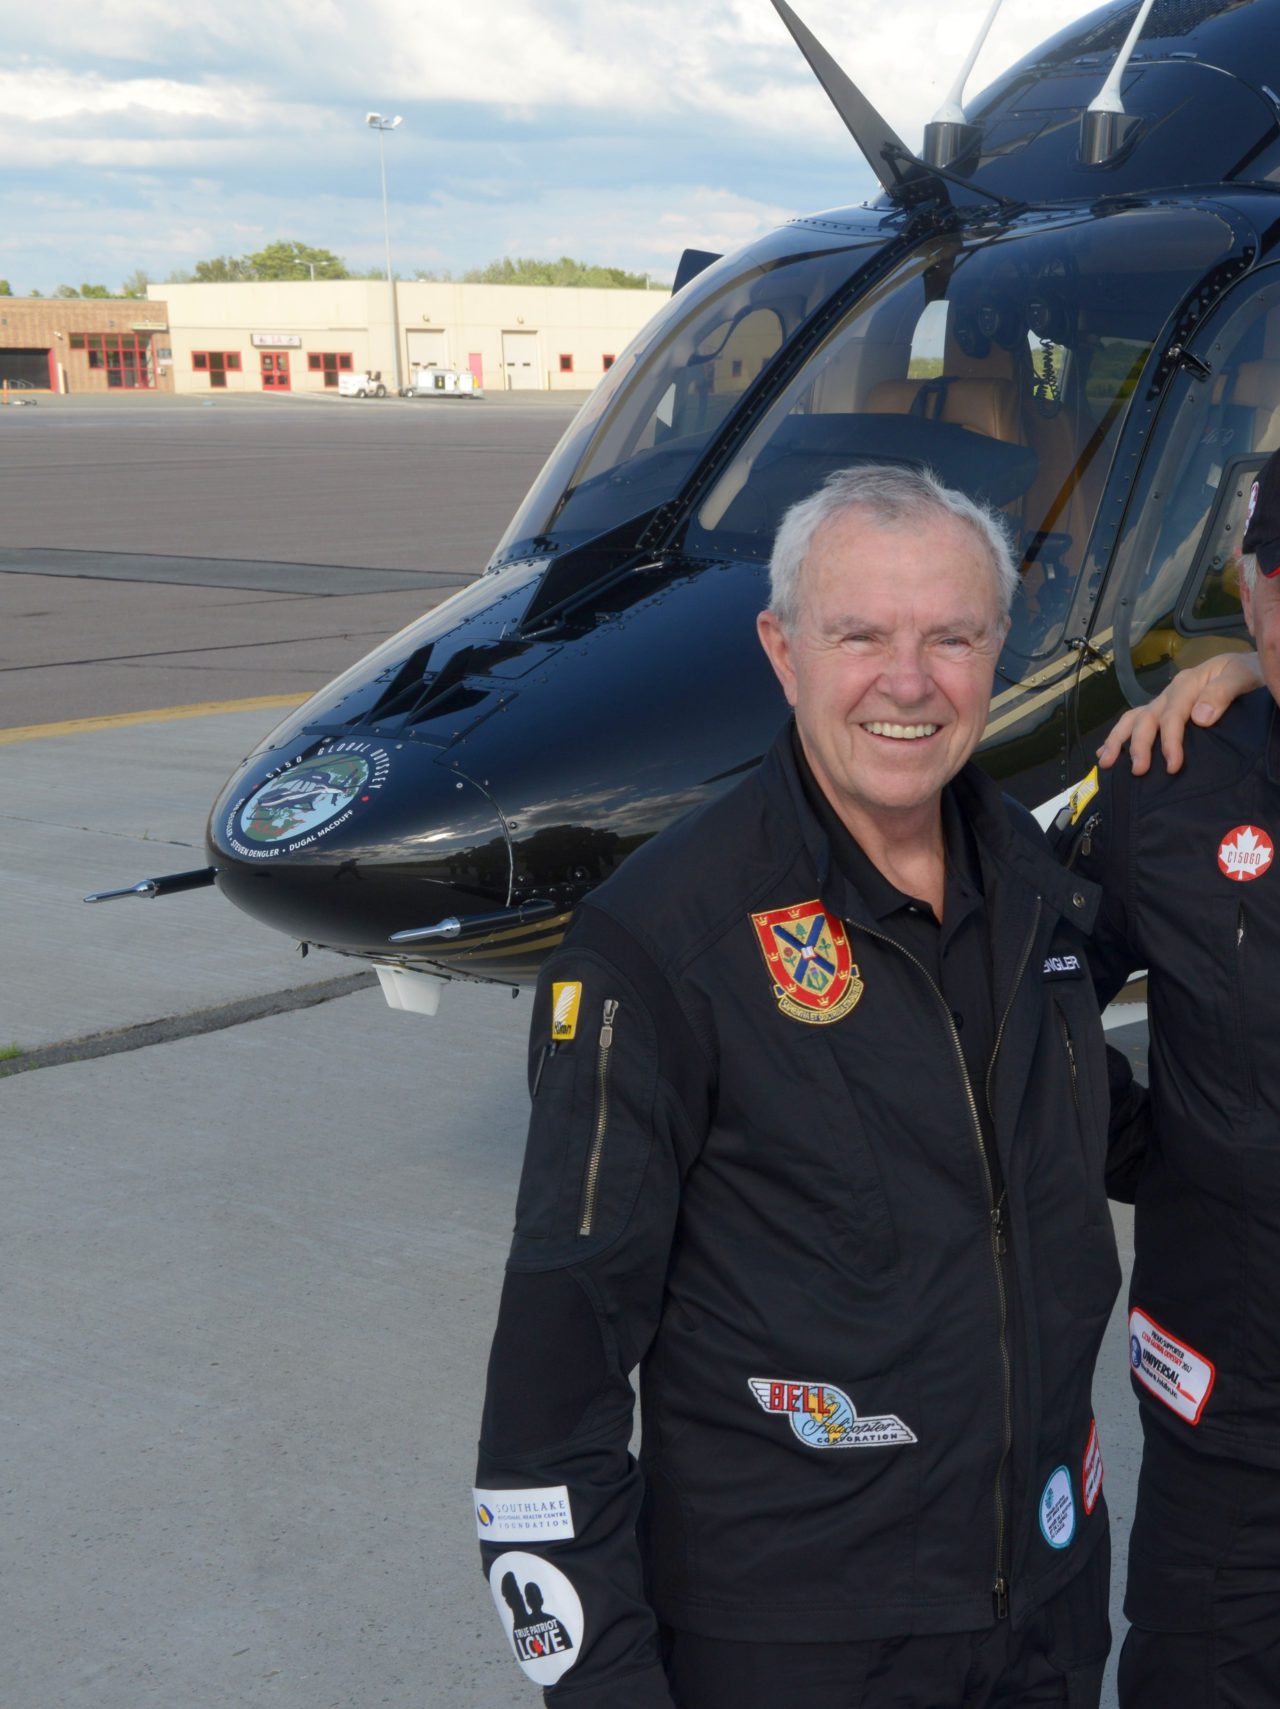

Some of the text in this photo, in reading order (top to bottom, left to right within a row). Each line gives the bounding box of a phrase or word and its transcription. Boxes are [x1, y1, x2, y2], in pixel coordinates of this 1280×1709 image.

[230, 840, 250, 856] STEVEN
[248, 848, 280, 858] DENGLER
[289, 835, 317, 851] DUGAL
[317, 810, 354, 837] MACDUFF
[1143, 1348, 1179, 1384] UNIVERSAL
[770, 1382, 830, 1414] BELL
[802, 1402, 895, 1440] Helicopter
[817, 1433, 898, 1444] CORPORATION
[496, 1500, 566, 1512] SOUTHLAKE
[499, 1520, 568, 1528] FOUNDATION
[514, 1618, 558, 1638] TRUE PATRIOT
[518, 1628, 566, 1660] LOVE
